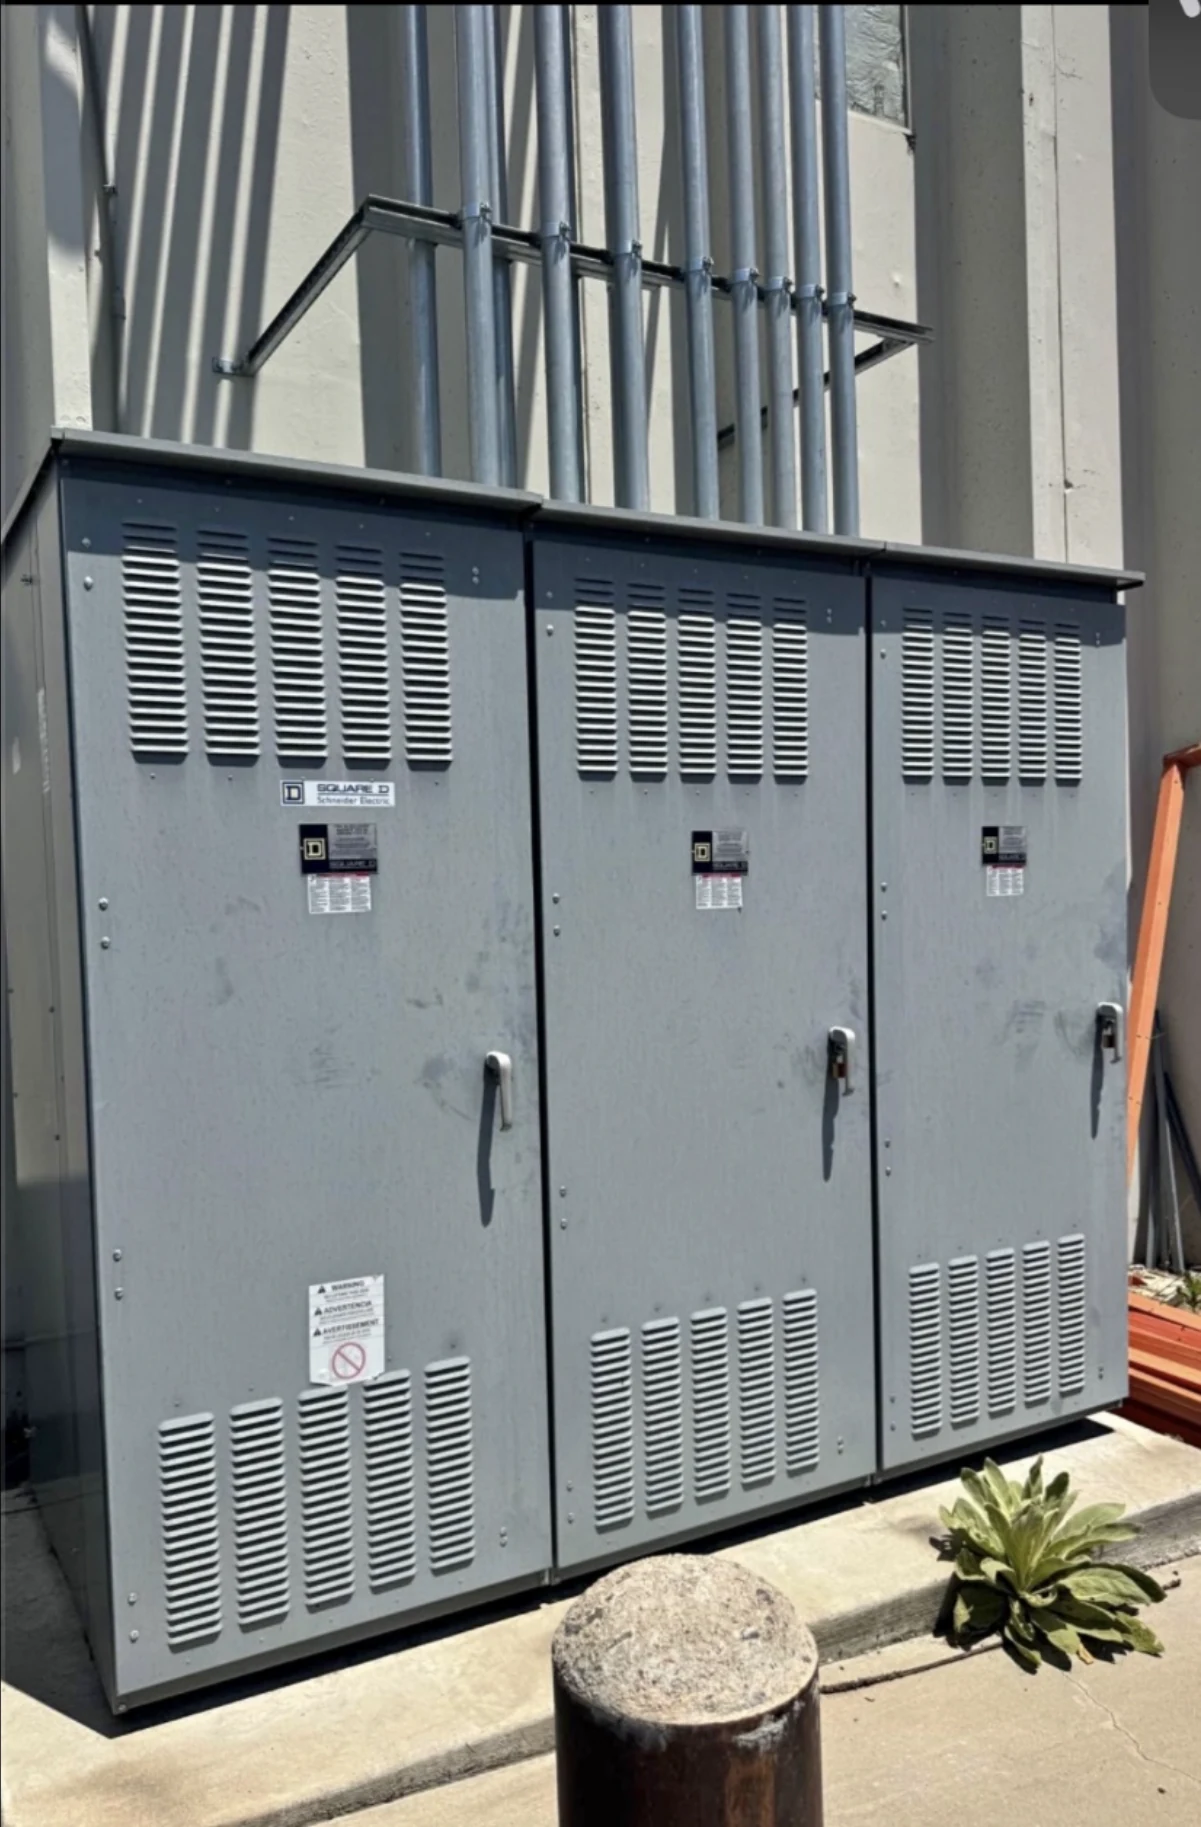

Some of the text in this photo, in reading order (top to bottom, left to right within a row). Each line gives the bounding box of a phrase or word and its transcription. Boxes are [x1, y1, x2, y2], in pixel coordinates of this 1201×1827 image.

[317, 783, 390, 794] SQUARE D
[317, 796, 389, 805] Schneider Electric
[332, 1280, 364, 1291] WARNING
[324, 1300, 371, 1313] ADVERTENCIA
[323, 1318, 378, 1334] AVERTISSEMENT
